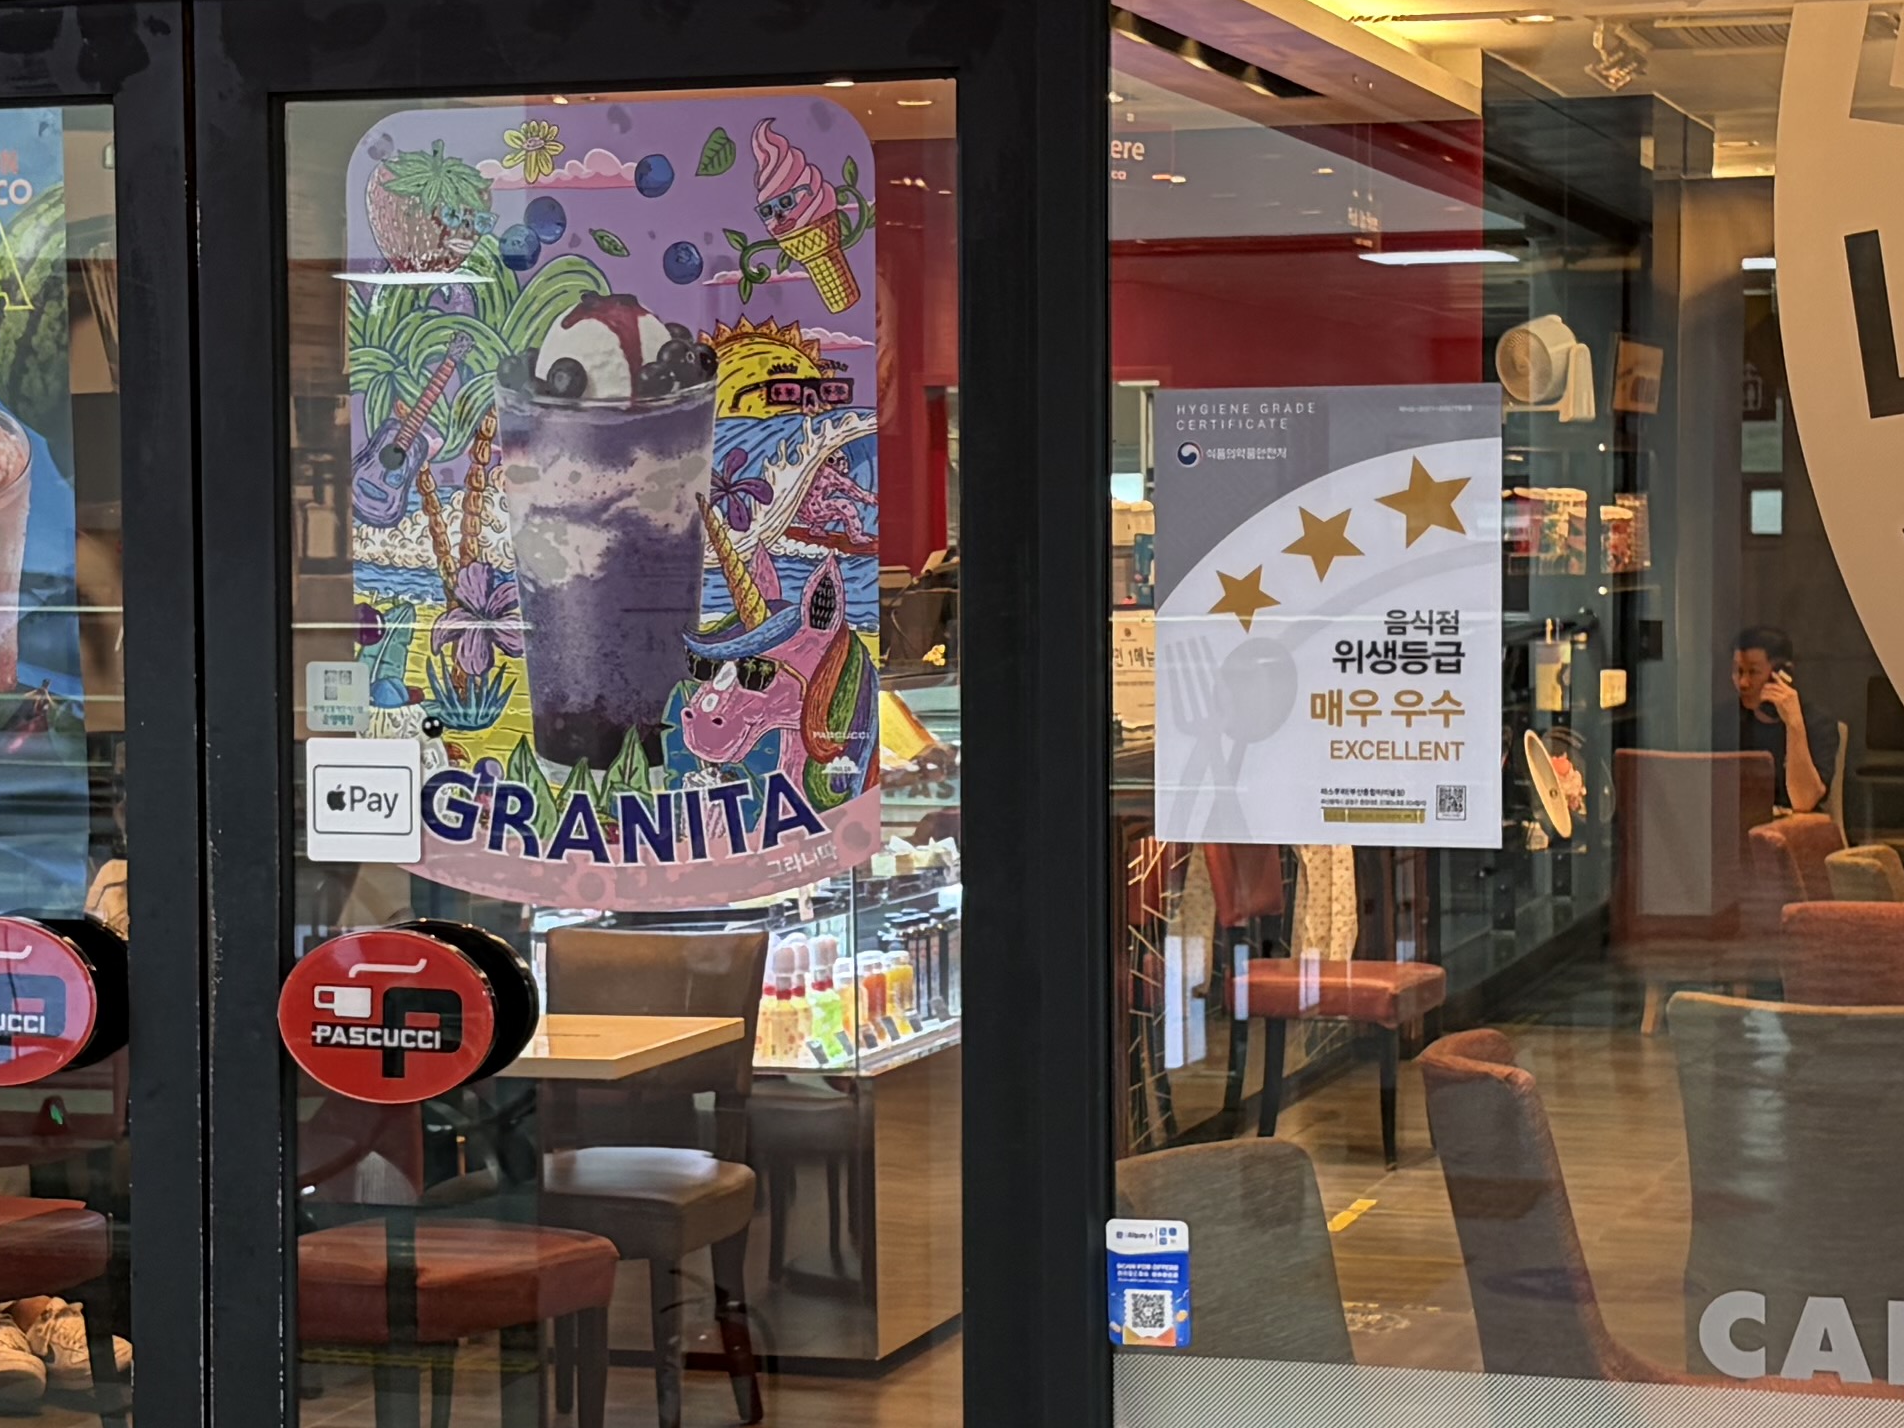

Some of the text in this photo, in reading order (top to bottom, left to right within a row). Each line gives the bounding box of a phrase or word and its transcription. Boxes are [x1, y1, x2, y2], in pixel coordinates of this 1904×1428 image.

[1177, 402, 1316, 415] HYGIENE GRADE
[1176, 418, 1288, 431] CERTIFICATE
[1384, 609, 1460, 636] 음식점
[1332, 640, 1466, 675] 위생등급
[1310, 688, 1466, 729] 매우 우수
[1330, 739, 1465, 761] EXCELLENT
[349, 787, 399, 818] Pay
[419, 770, 831, 865] GRANITA
[311, 1024, 442, 1050] PASCUCCI
